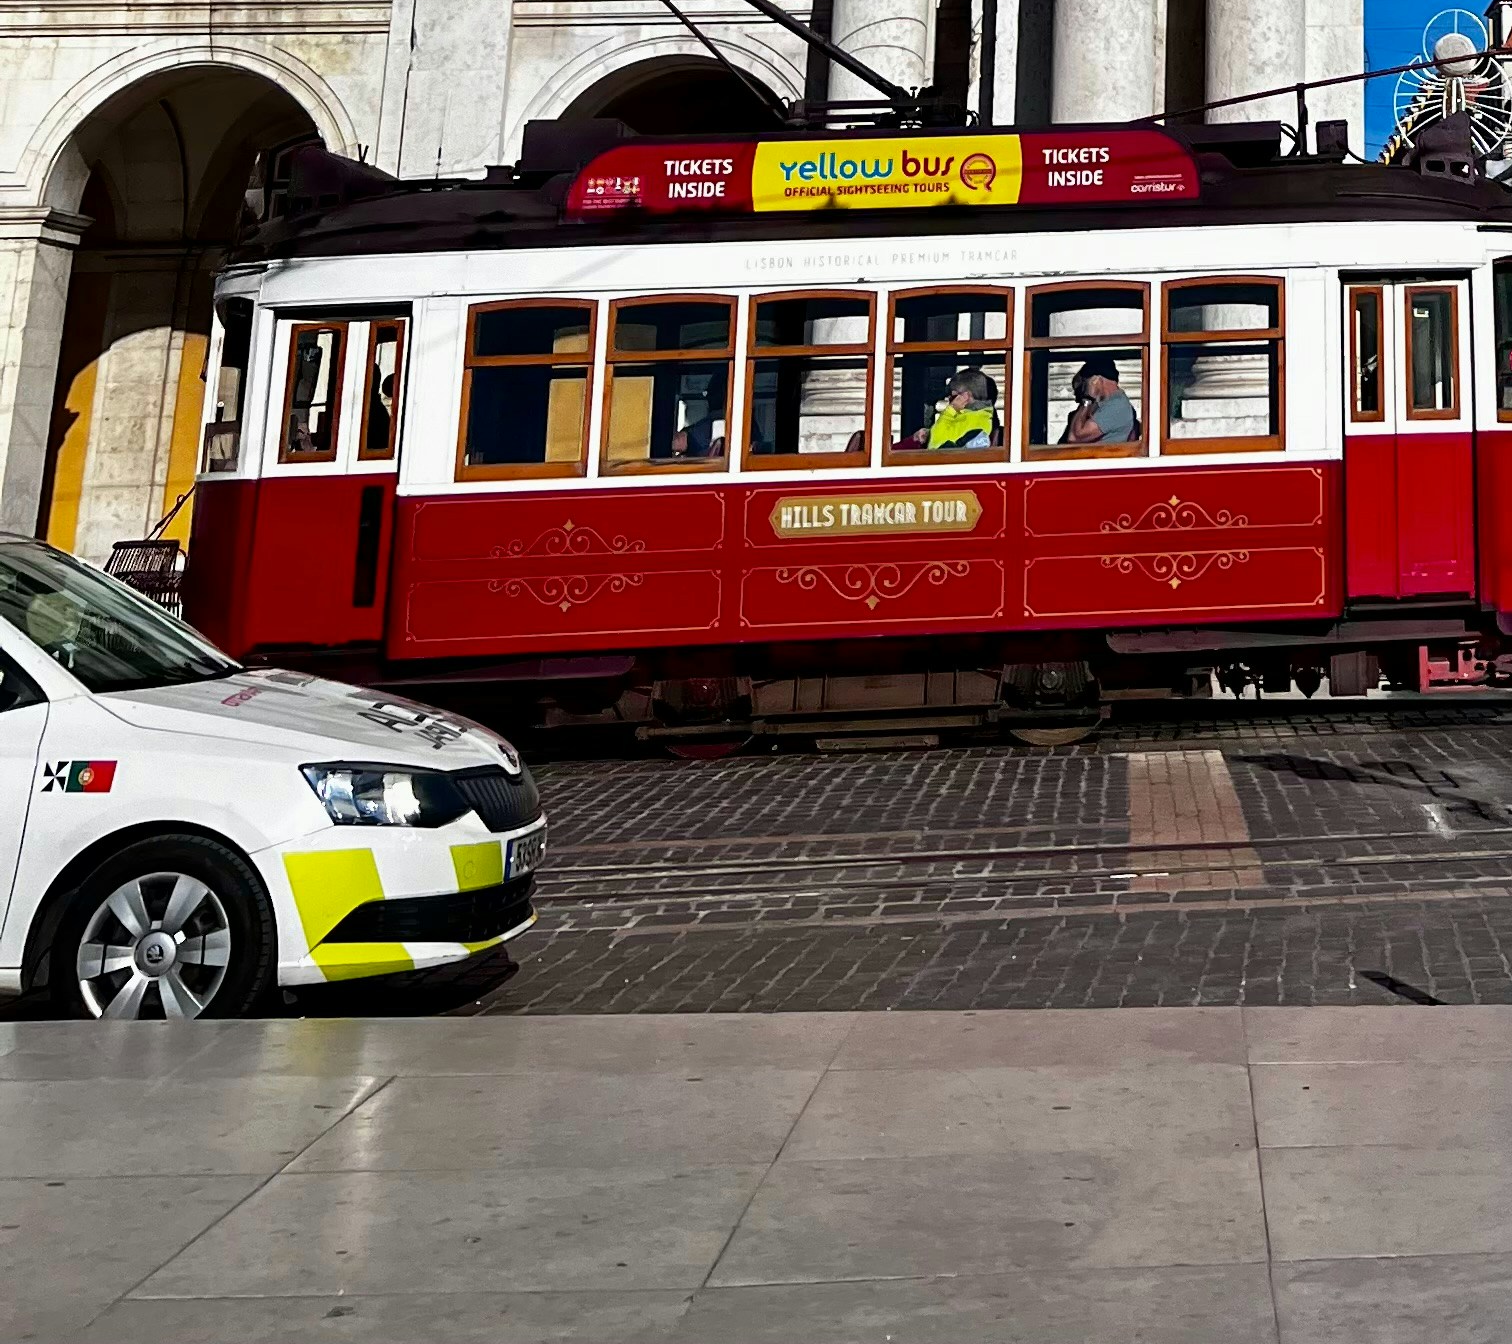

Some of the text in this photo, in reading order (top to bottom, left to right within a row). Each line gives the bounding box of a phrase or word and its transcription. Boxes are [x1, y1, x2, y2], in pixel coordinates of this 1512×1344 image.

[780, 149, 955, 181] yellow bus
[1042, 147, 1110, 165] TICKETS
[664, 159, 733, 176] TICKETS
[1048, 169, 1104, 187] INSIDE
[668, 181, 726, 198] INSIDE
[784, 181, 950, 198] OFFICIAL SIGHTSEEING TOURS
[745, 249, 1018, 270] LISBON HISTORICAL PREMIUM TRAMCAR
[781, 499, 968, 529] HILLS TRAMCAR TOUR
